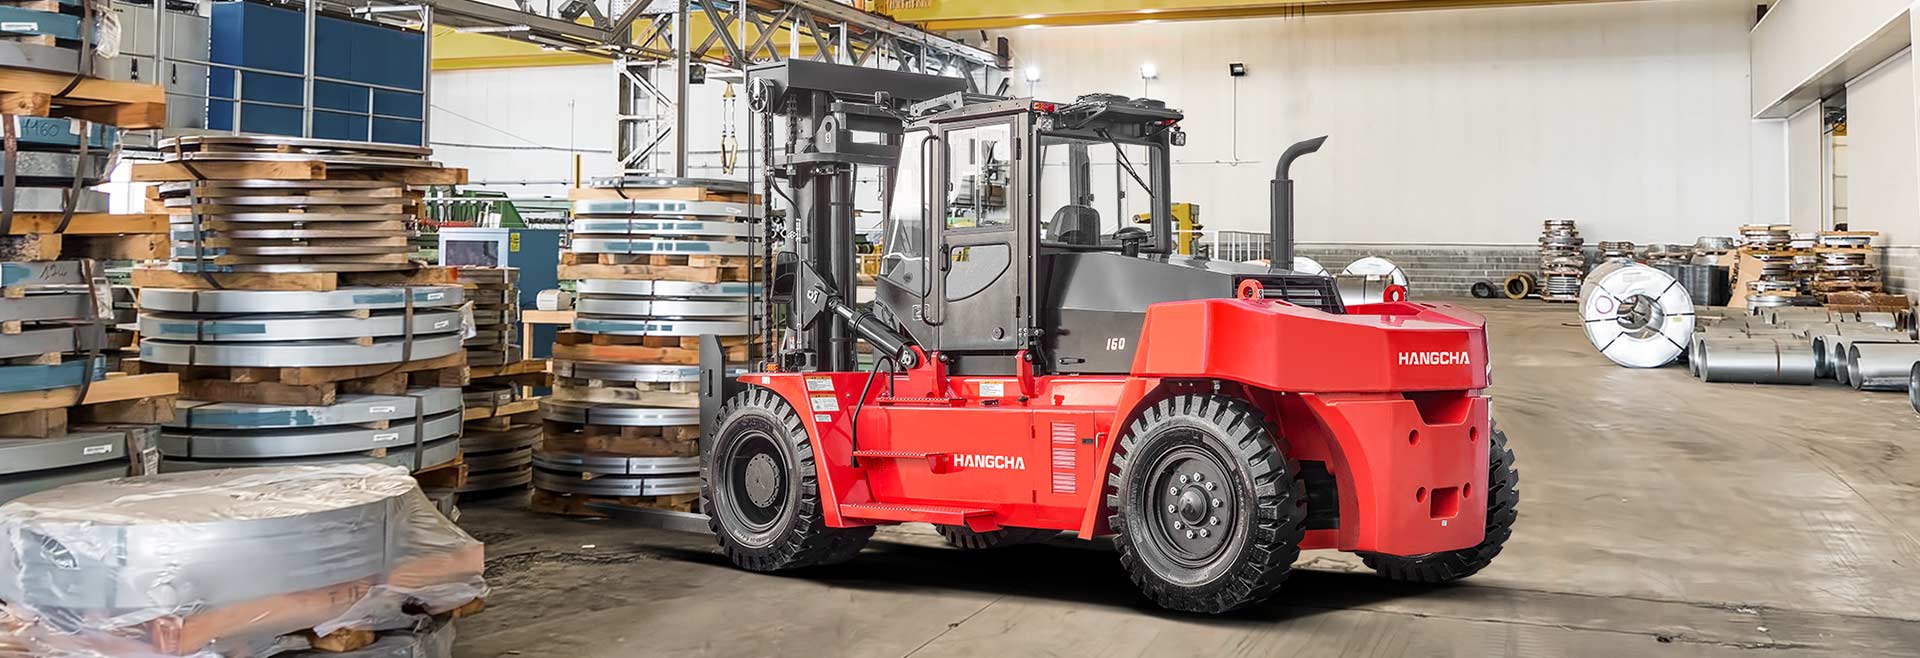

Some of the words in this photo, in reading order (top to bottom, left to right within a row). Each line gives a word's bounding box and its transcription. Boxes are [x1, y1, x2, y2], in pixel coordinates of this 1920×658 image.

[1106, 337, 1125, 351] 160
[1398, 352, 1470, 365] HANGCHA
[953, 453, 1026, 470] HANGCHA
